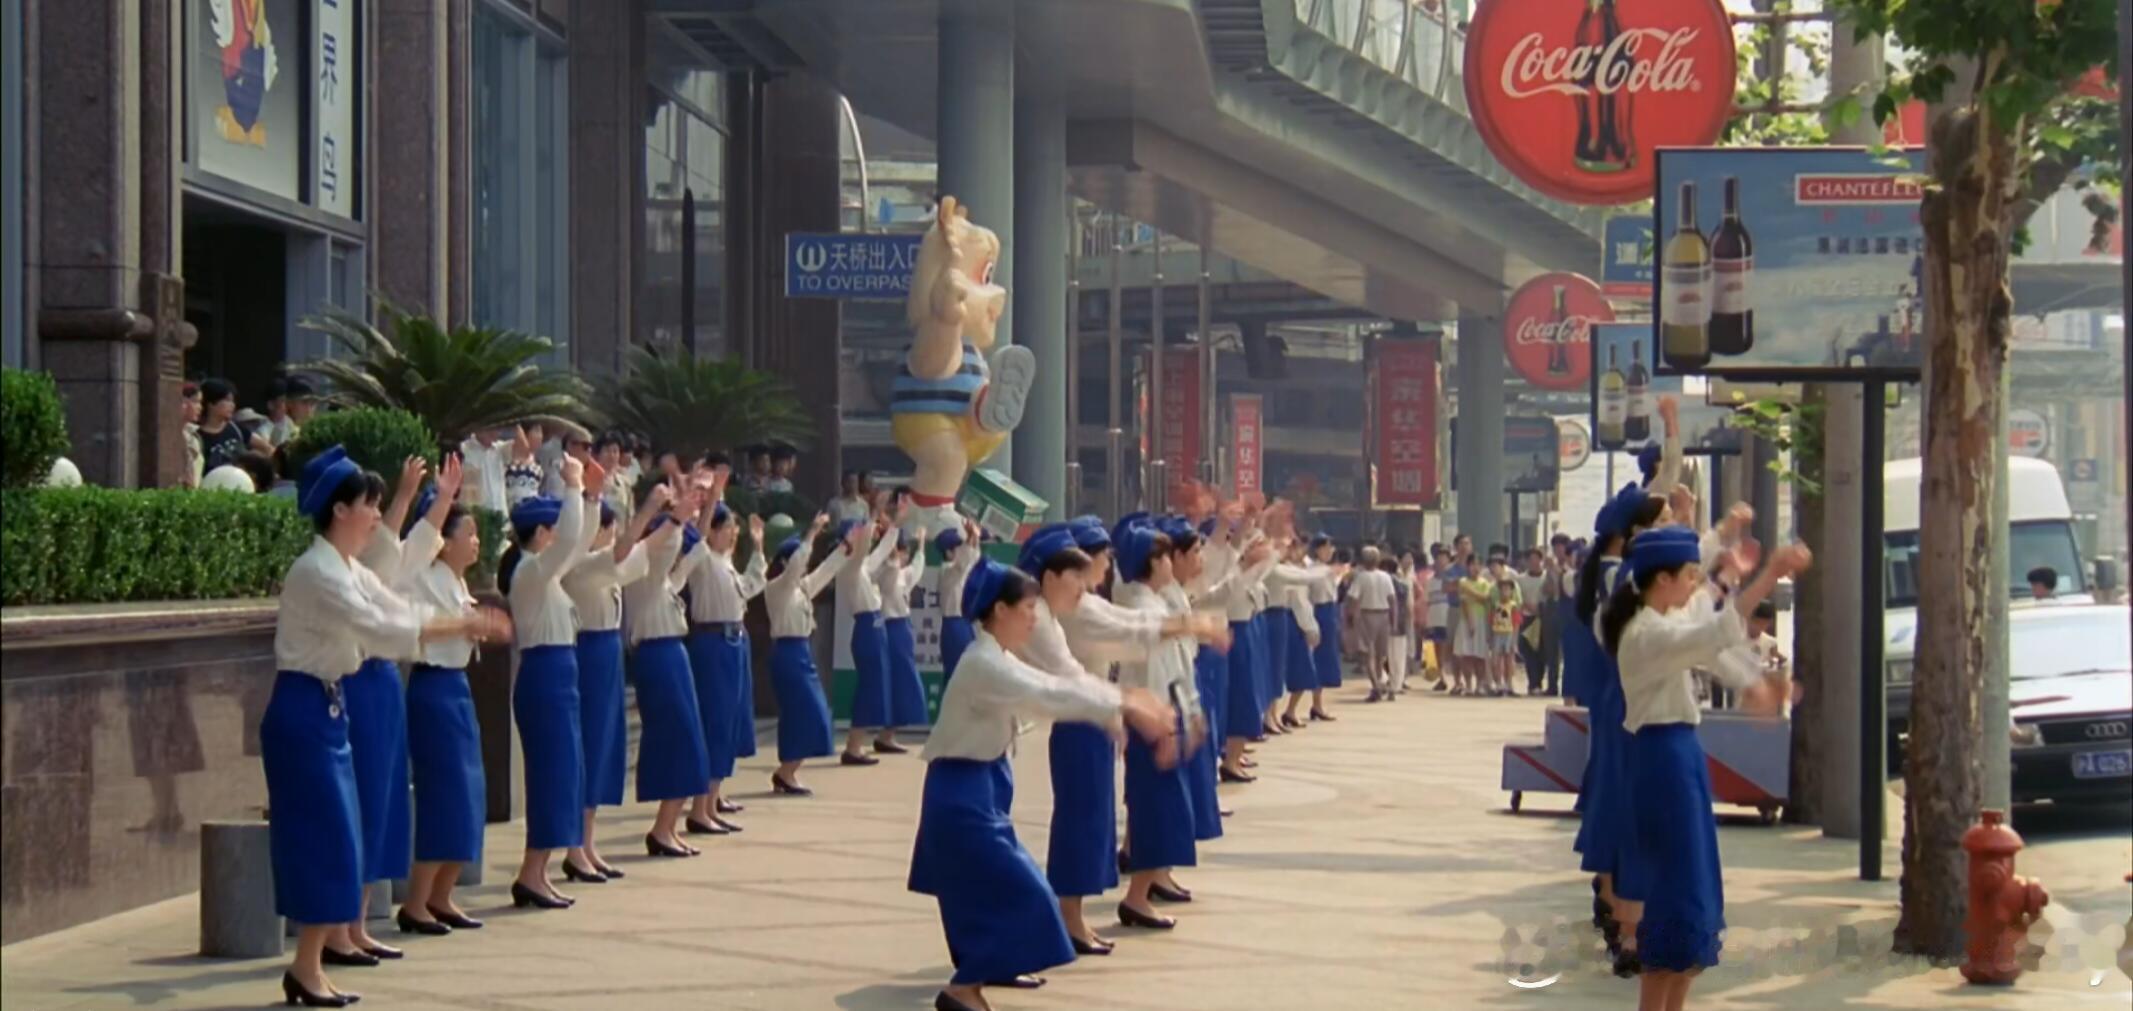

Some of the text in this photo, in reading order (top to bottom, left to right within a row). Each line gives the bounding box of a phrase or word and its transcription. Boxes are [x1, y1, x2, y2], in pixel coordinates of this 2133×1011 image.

[1501, 26, 1700, 98] Coca-Cola
[321, 0, 337, 202] 界鸟
[797, 275, 821, 290] TO
